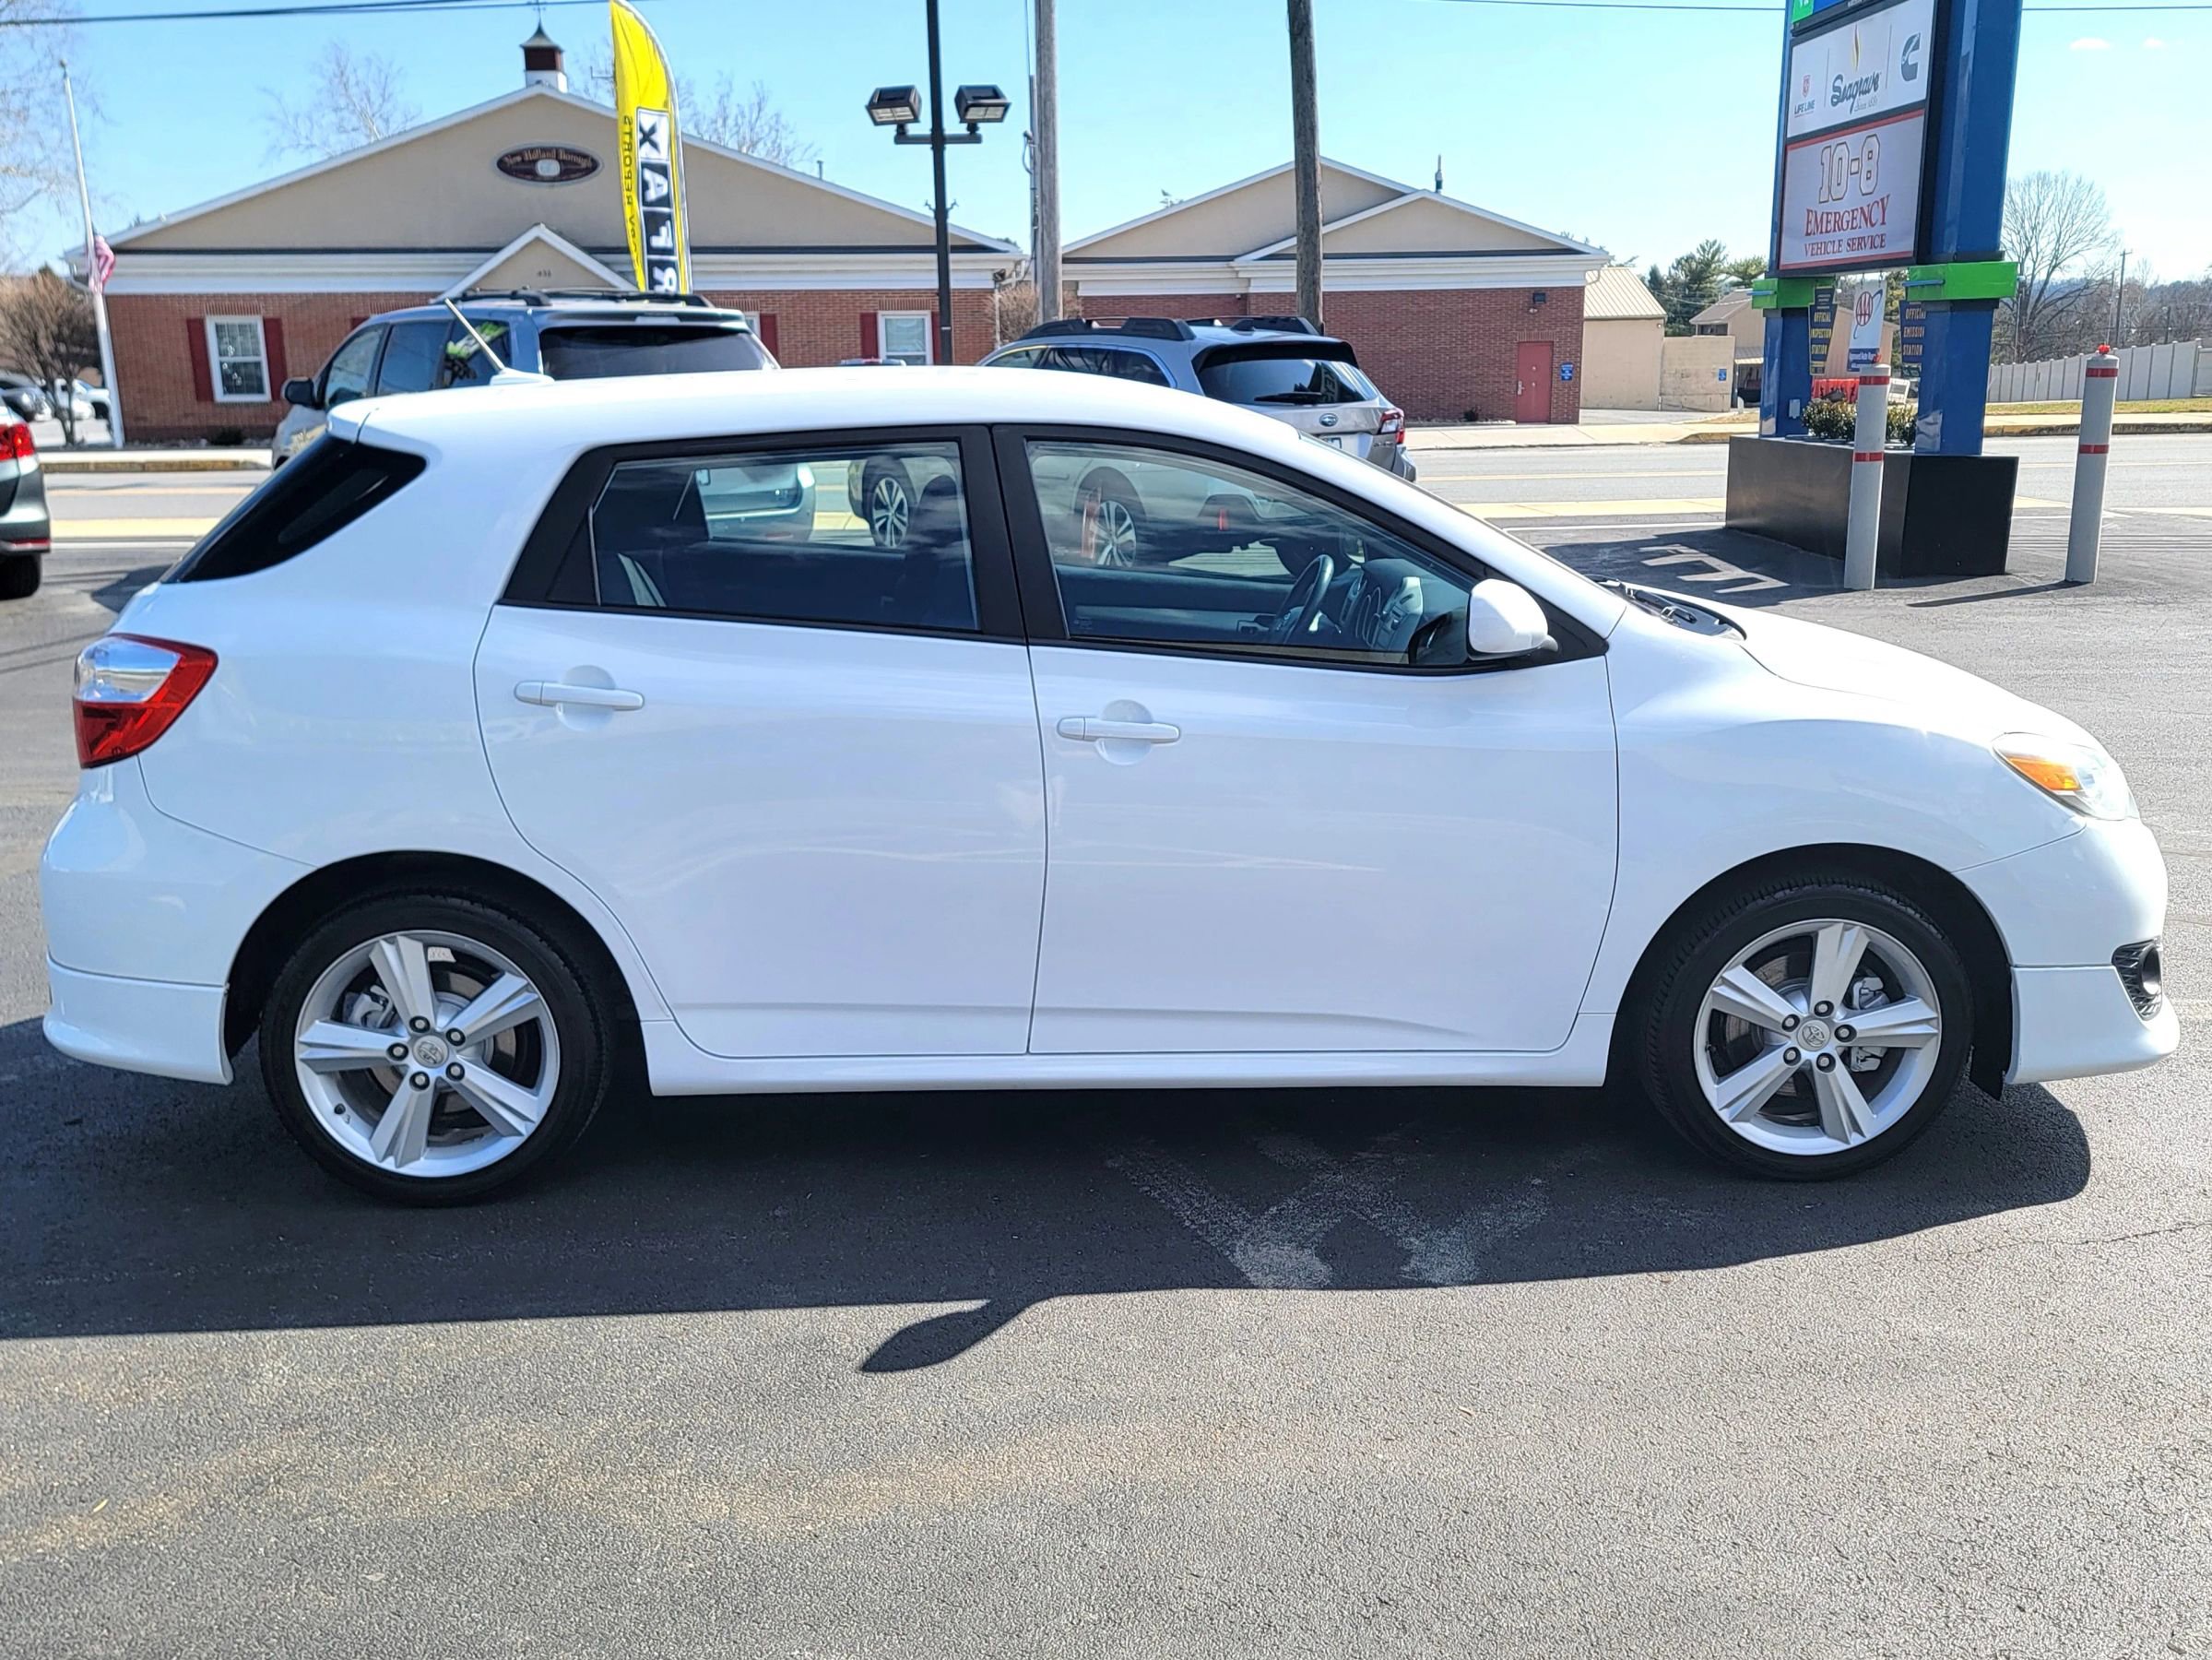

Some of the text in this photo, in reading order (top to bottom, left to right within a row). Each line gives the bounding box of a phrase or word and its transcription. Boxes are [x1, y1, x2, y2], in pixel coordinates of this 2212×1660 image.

[1830, 72, 1880, 114] Seagrave
[1818, 134, 1880, 204] 10-8
[1804, 195, 1889, 237] EMERGENCY
[1804, 233, 1887, 257] VEHICLE SERVICE
